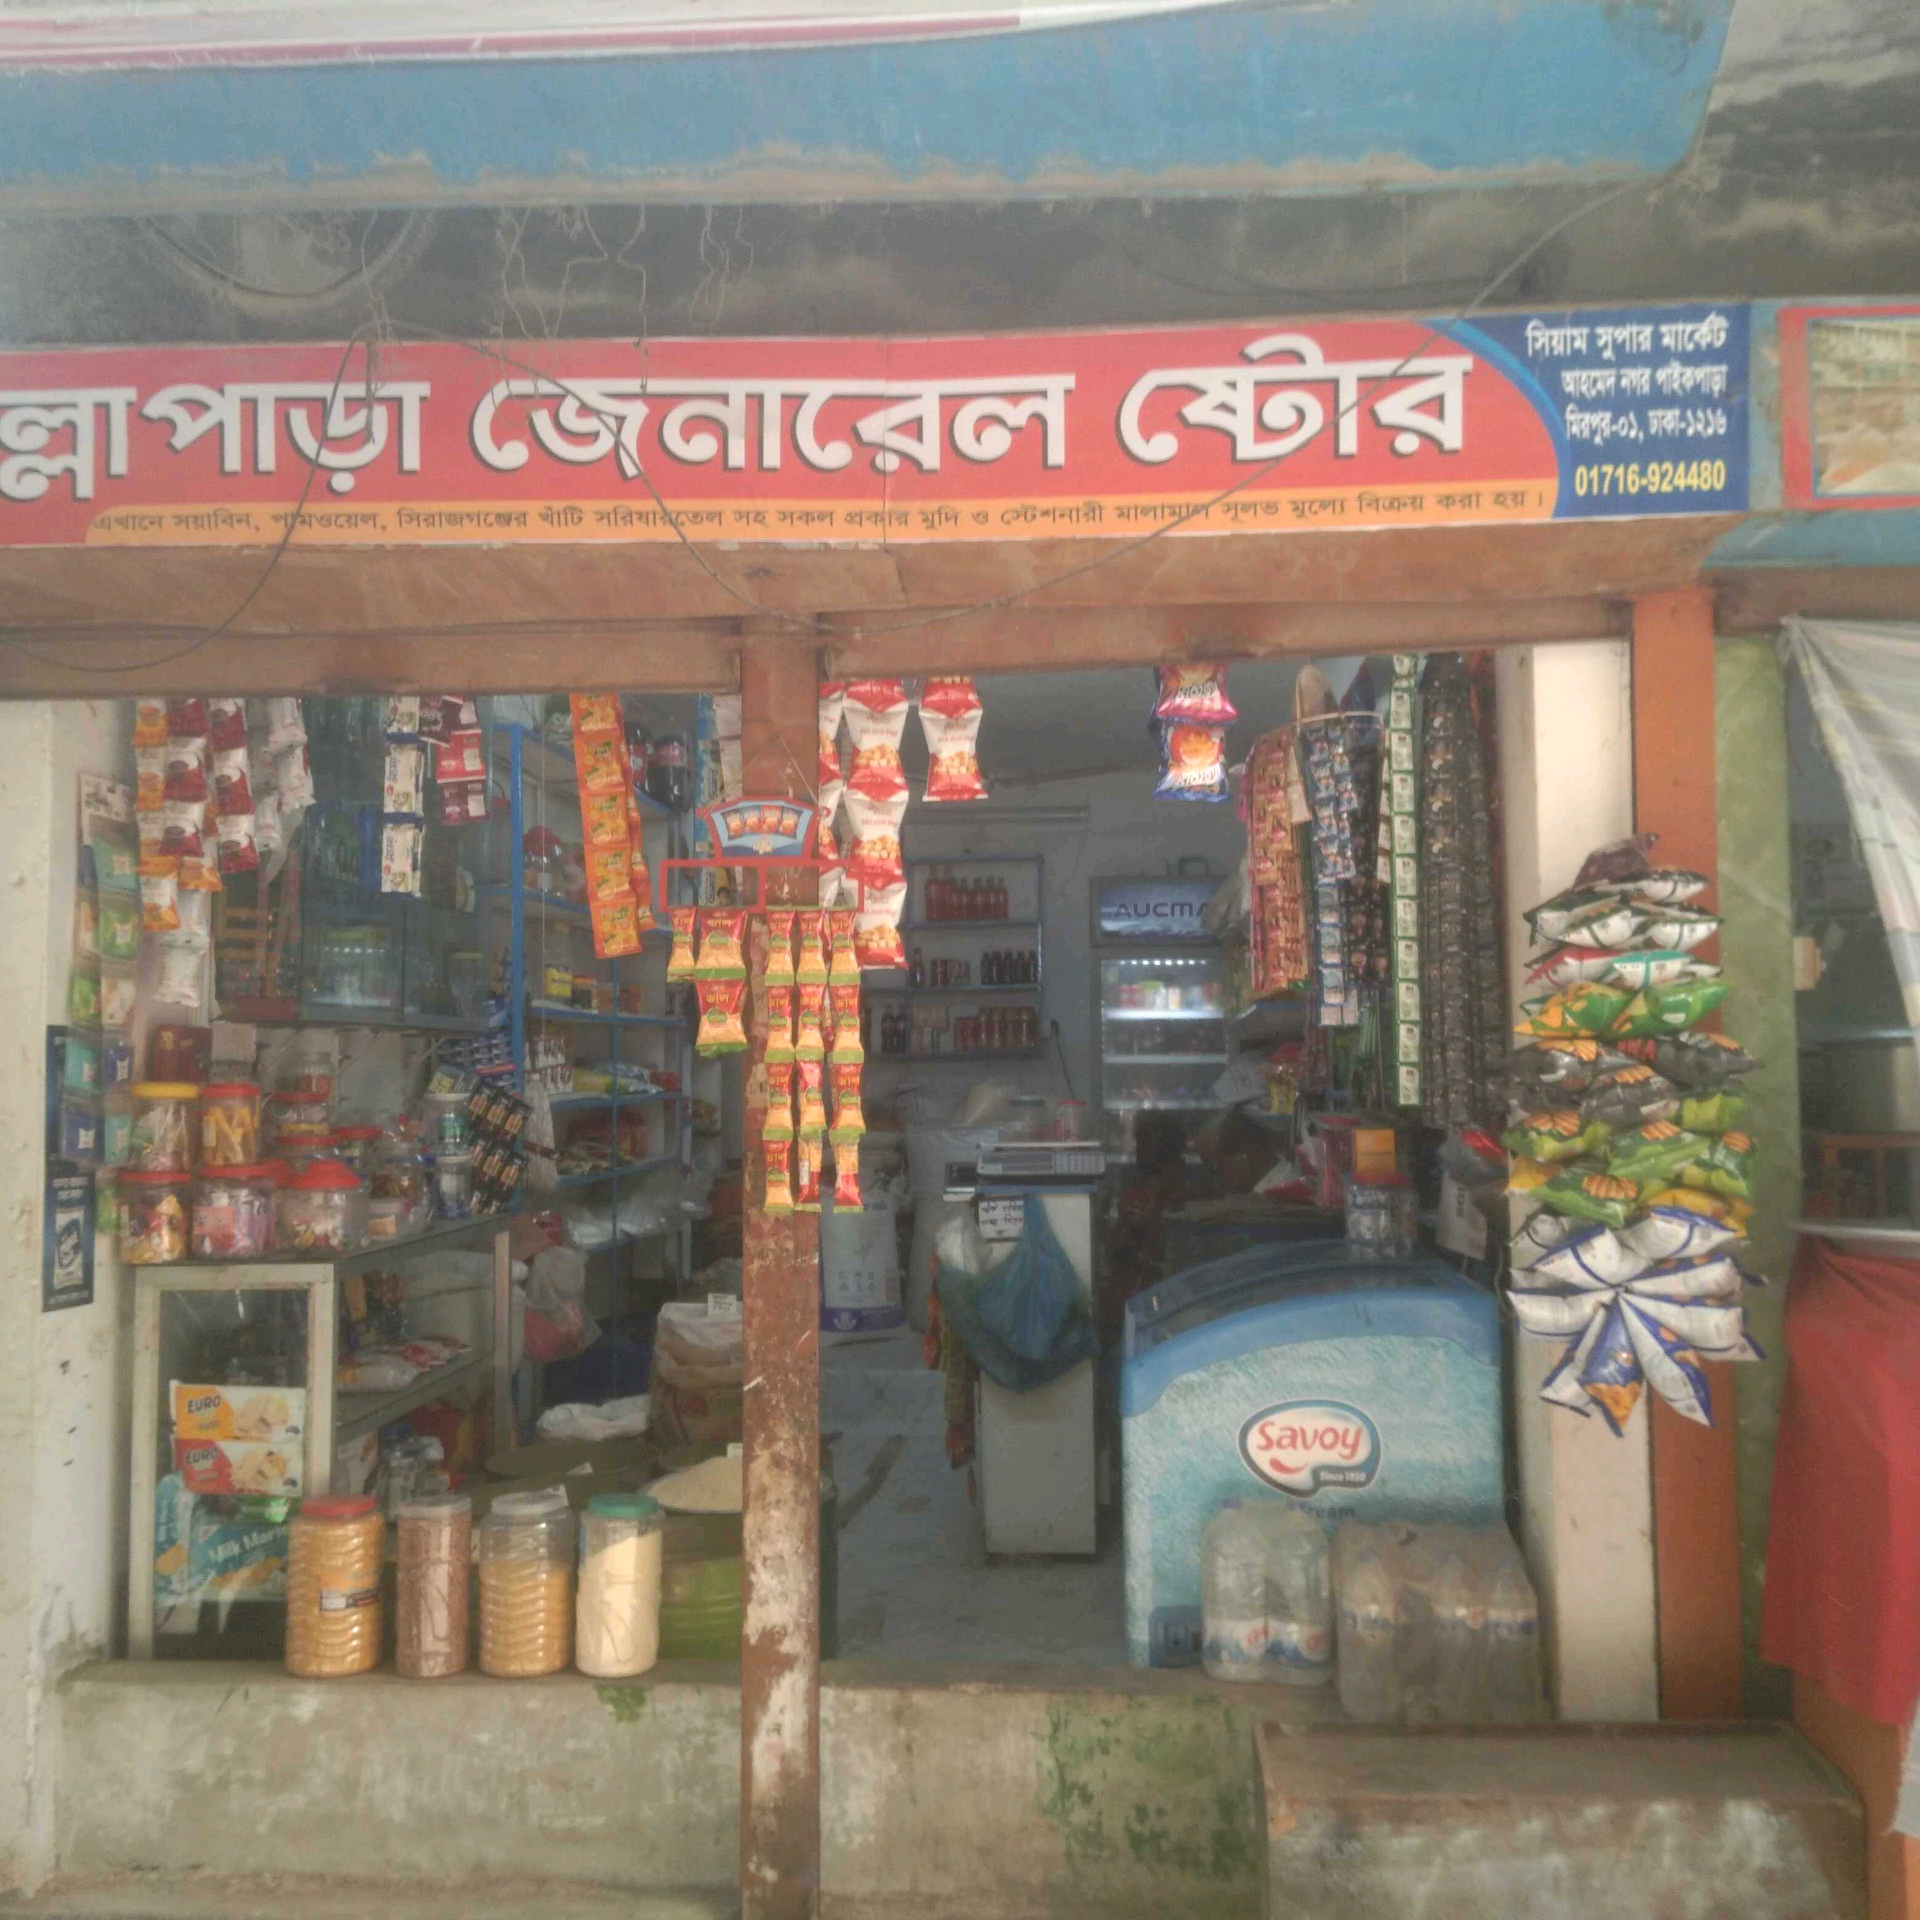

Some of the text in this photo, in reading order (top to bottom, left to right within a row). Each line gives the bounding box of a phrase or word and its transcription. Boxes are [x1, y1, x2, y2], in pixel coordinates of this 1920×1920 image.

[1526, 311, 1730, 362] সিয়াম সুপার মার্কেট
[1619, 366, 1652, 396] নগর
[1655, 358, 1728, 398] পাইকপাড়া
[472, 374, 1076, 479] জেনারেল
[1117, 335, 1474, 464] ষ্টোর
[1575, 458, 1727, 497] 01716-924480
[92, 511, 163, 531] এখানে
[733, 509, 769, 529] সহ
[777, 509, 837, 528] সকল
[971, 508, 991, 526] ও
[1116, 502, 1211, 524] মালামাল
[1435, 491, 1483, 511] করা
[187, 1395, 221, 1413] EURO
[185, 1447, 219, 1464] EURO
[1257, 1420, 1362, 1461] Savoy
